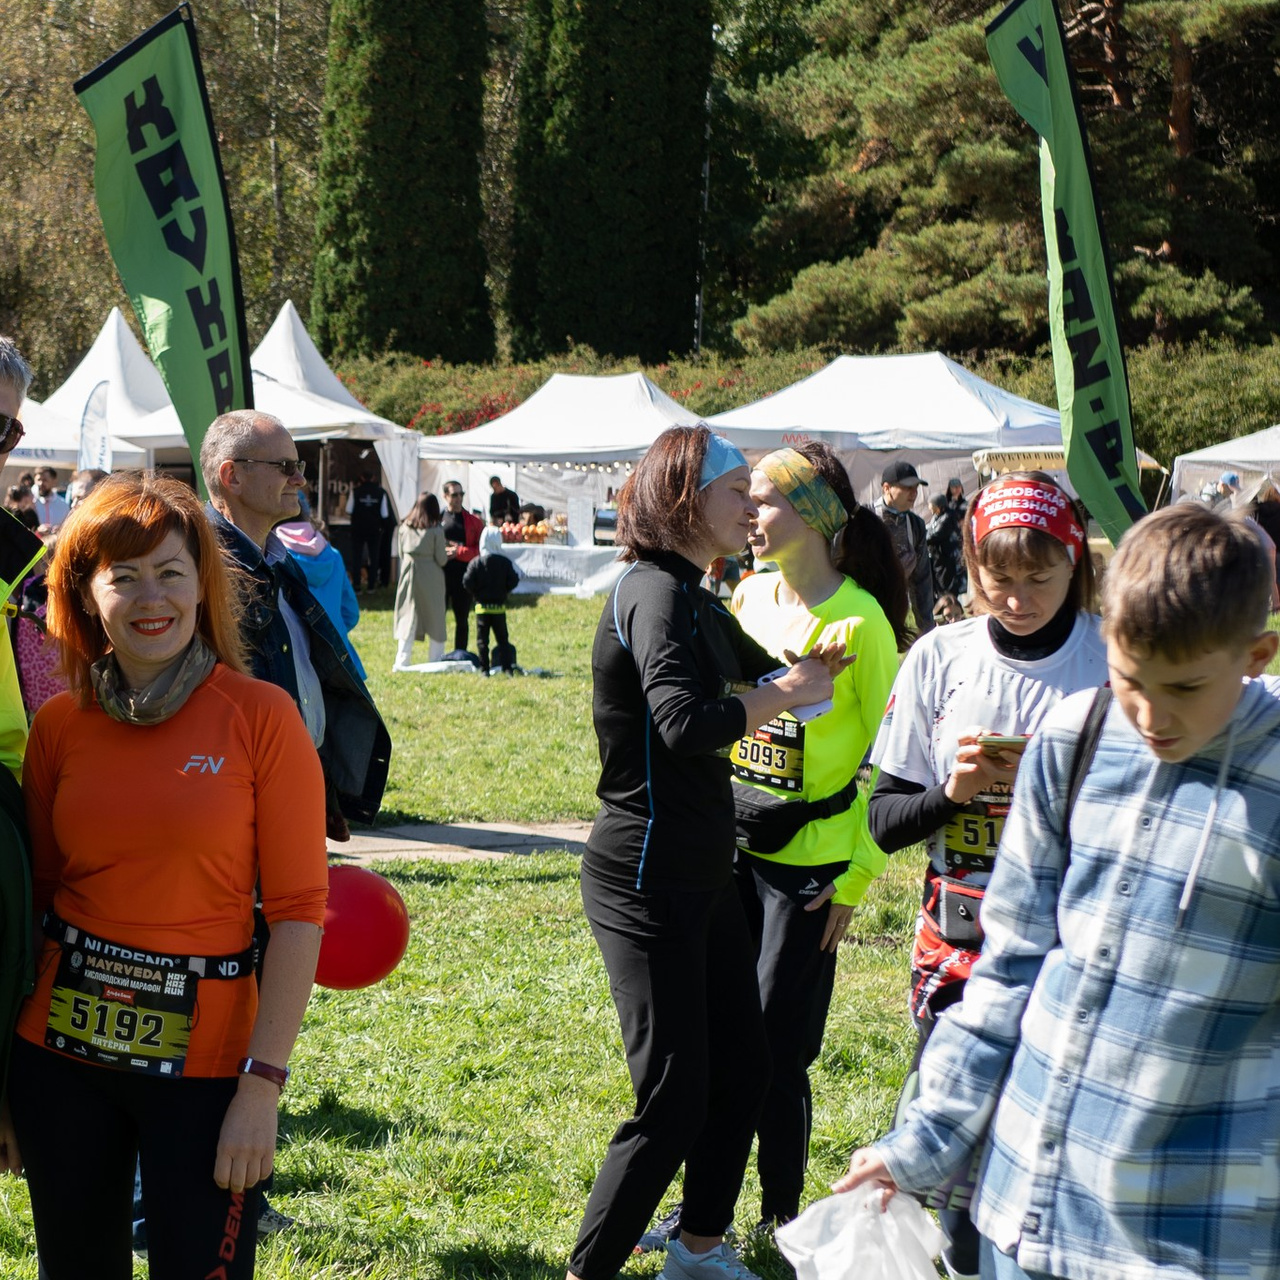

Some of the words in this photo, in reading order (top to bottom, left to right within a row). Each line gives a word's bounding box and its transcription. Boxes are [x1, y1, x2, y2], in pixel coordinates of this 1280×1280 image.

[978, 486, 1066, 509] МОСКОВСКАЯ
[984, 498, 1058, 518] ЖЕЛЕЗНАЯ
[989, 511, 1048, 529] ДОРОГА
[738, 738, 787, 771] 5093
[86, 955, 163, 982] MAYRVEDA
[84, 969, 130, 987] КИСЛОВОДСКИЙ
[130, 979, 161, 994] МАРАФОН
[164, 987, 184, 996] RUN
[70, 996, 164, 1048] 5192
[91, 1036, 131, 1053] ПЯТЁРКА
